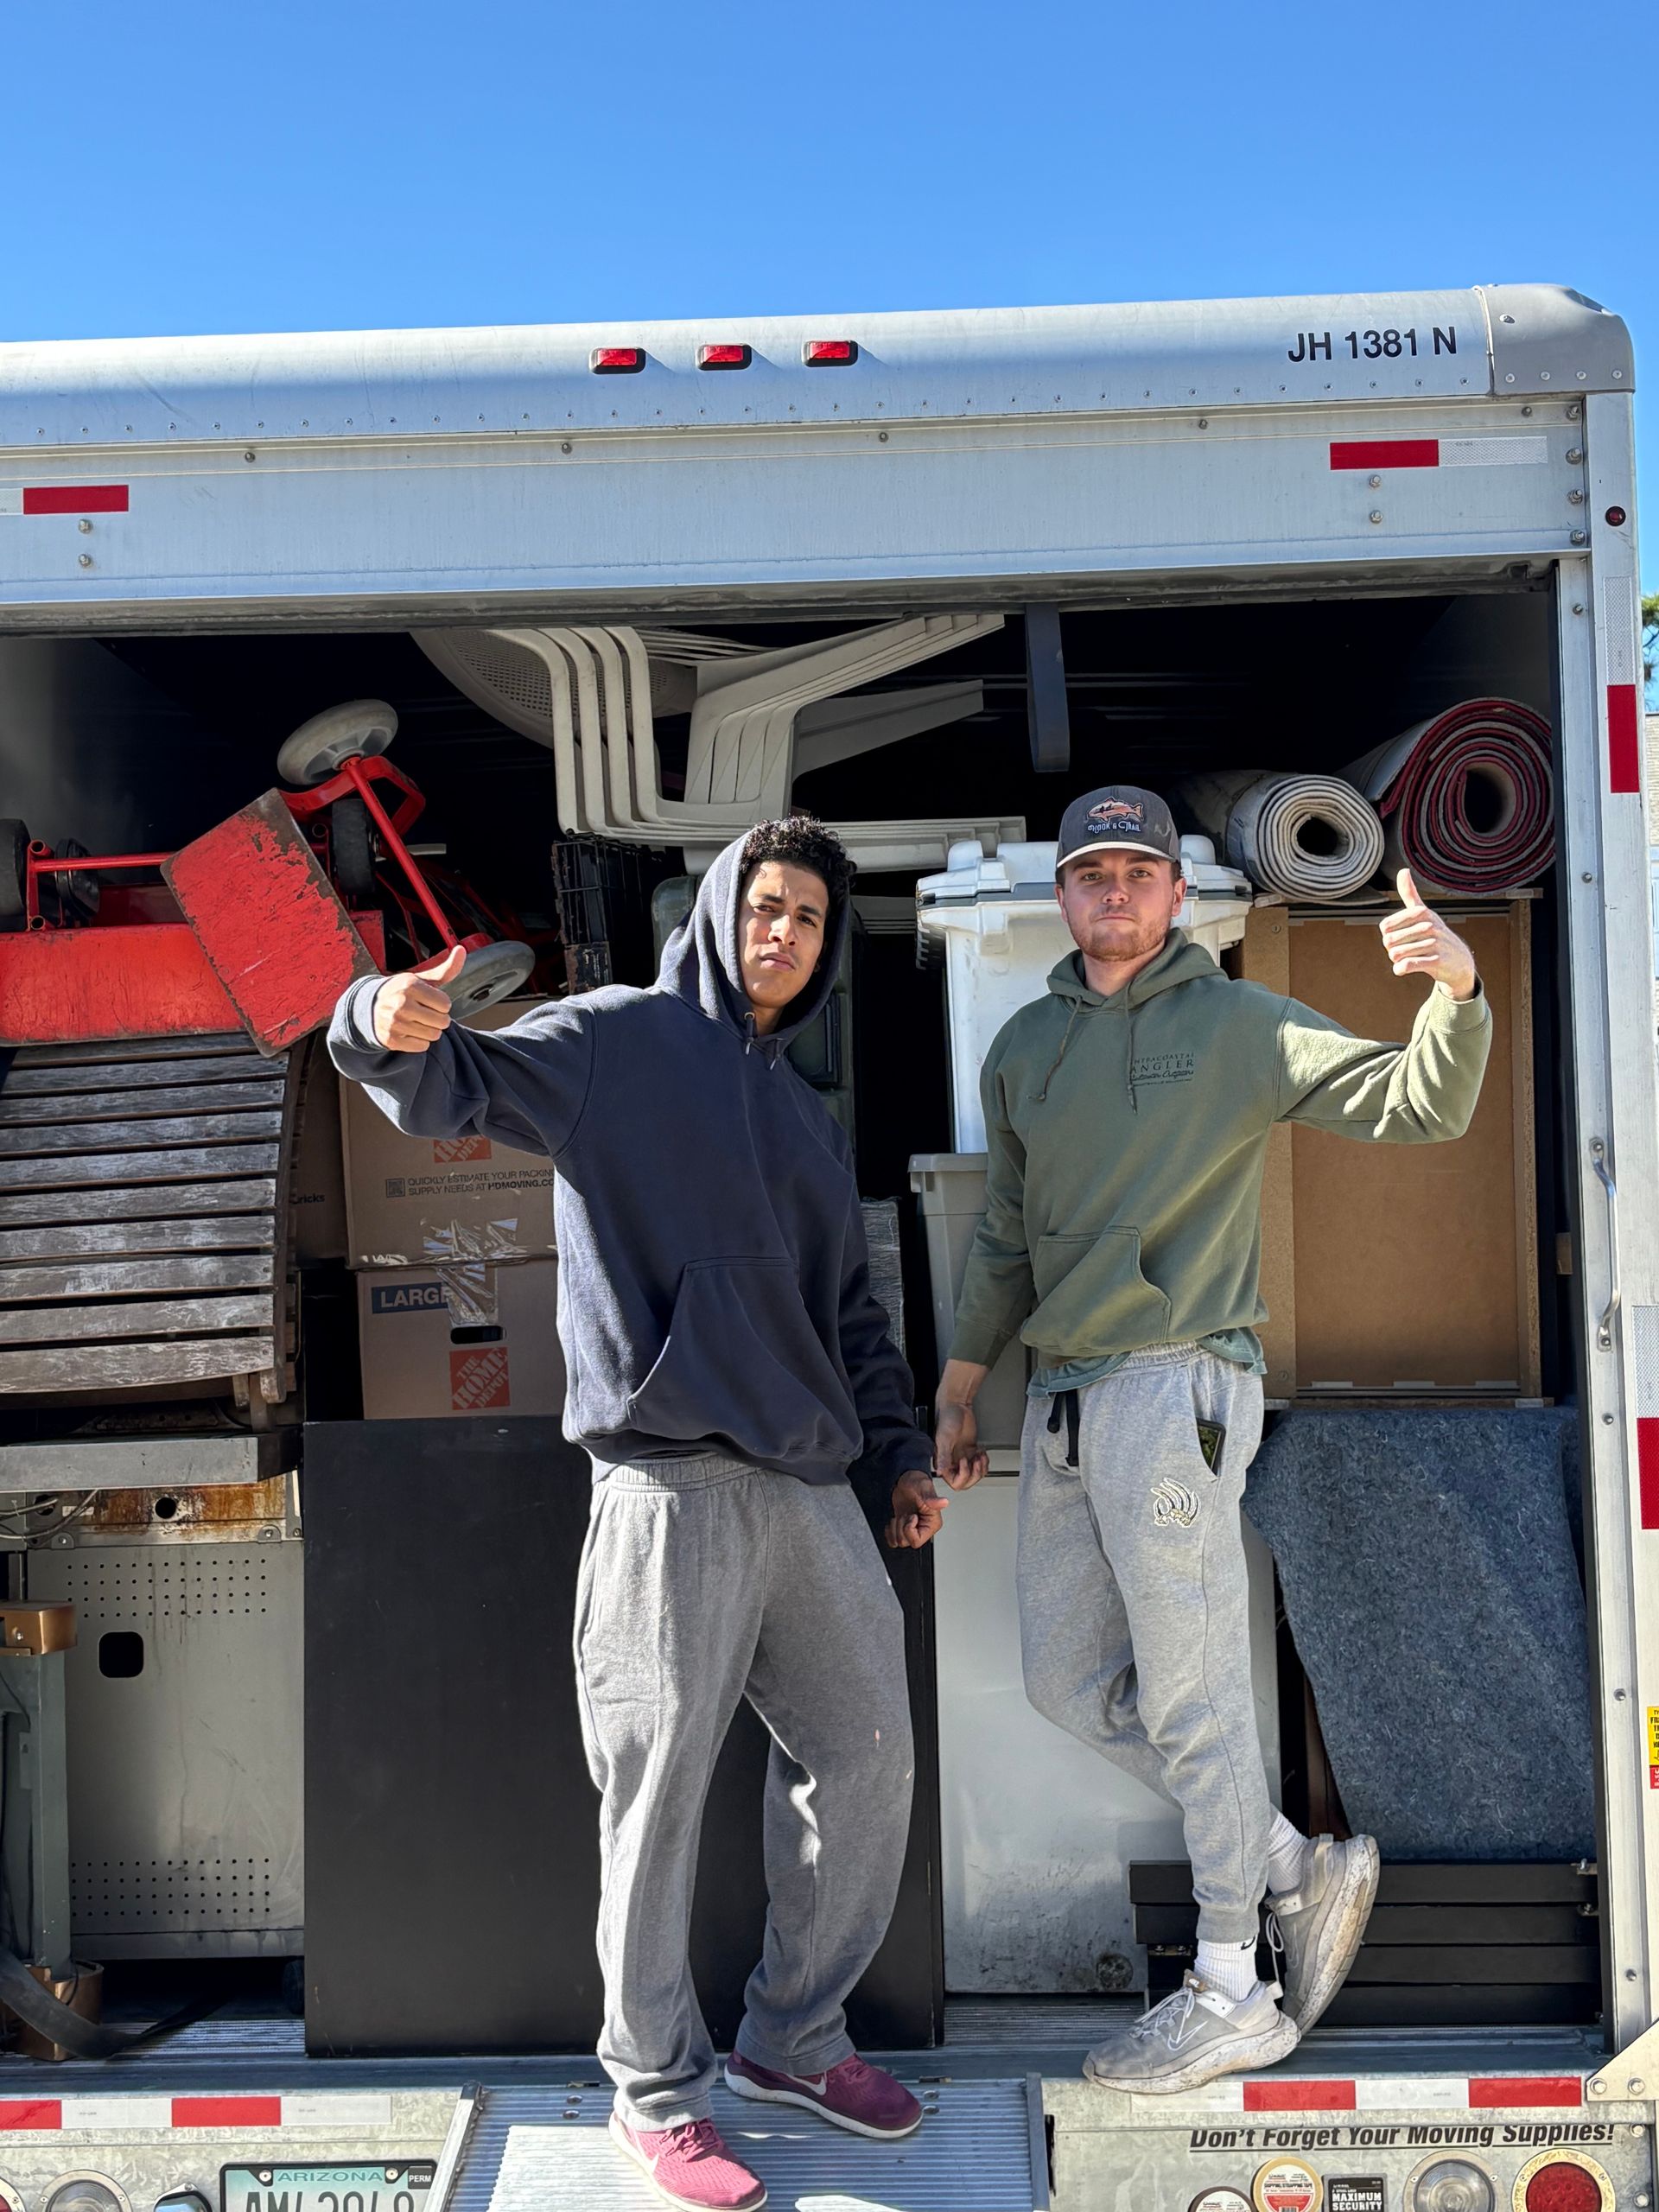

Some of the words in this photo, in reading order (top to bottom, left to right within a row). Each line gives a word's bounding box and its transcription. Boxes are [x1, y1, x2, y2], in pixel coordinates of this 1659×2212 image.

[1287, 331, 1332, 362] JH
[1344, 328, 1417, 359] 1381
[1433, 327, 1457, 354] N
[407, 1174, 445, 1186] QUICKLY
[448, 1172, 489, 1184] ESTIMATE
[491, 1170, 517, 1179] YOUR
[408, 1186, 442, 1196] SUPPLY
[444, 1185, 474, 1193] NEEDS
[456, 1356, 480, 1380] THE
[452, 1348, 508, 1409] HOME
[475, 1370, 508, 1408] DEPOT
[1262, 2128, 1338, 2151] Forget
[1348, 2127, 1400, 2145] Your
[1408, 2126, 1494, 2147] Moving
[1503, 2125, 1614, 2146] Supplies!
[277, 2171, 383, 2182] ARIZONA
[409, 2174, 432, 2183] PERM
[1332, 2192, 1382, 2202] MAXIMUM
[1332, 2201, 1382, 2211] SECURITY
